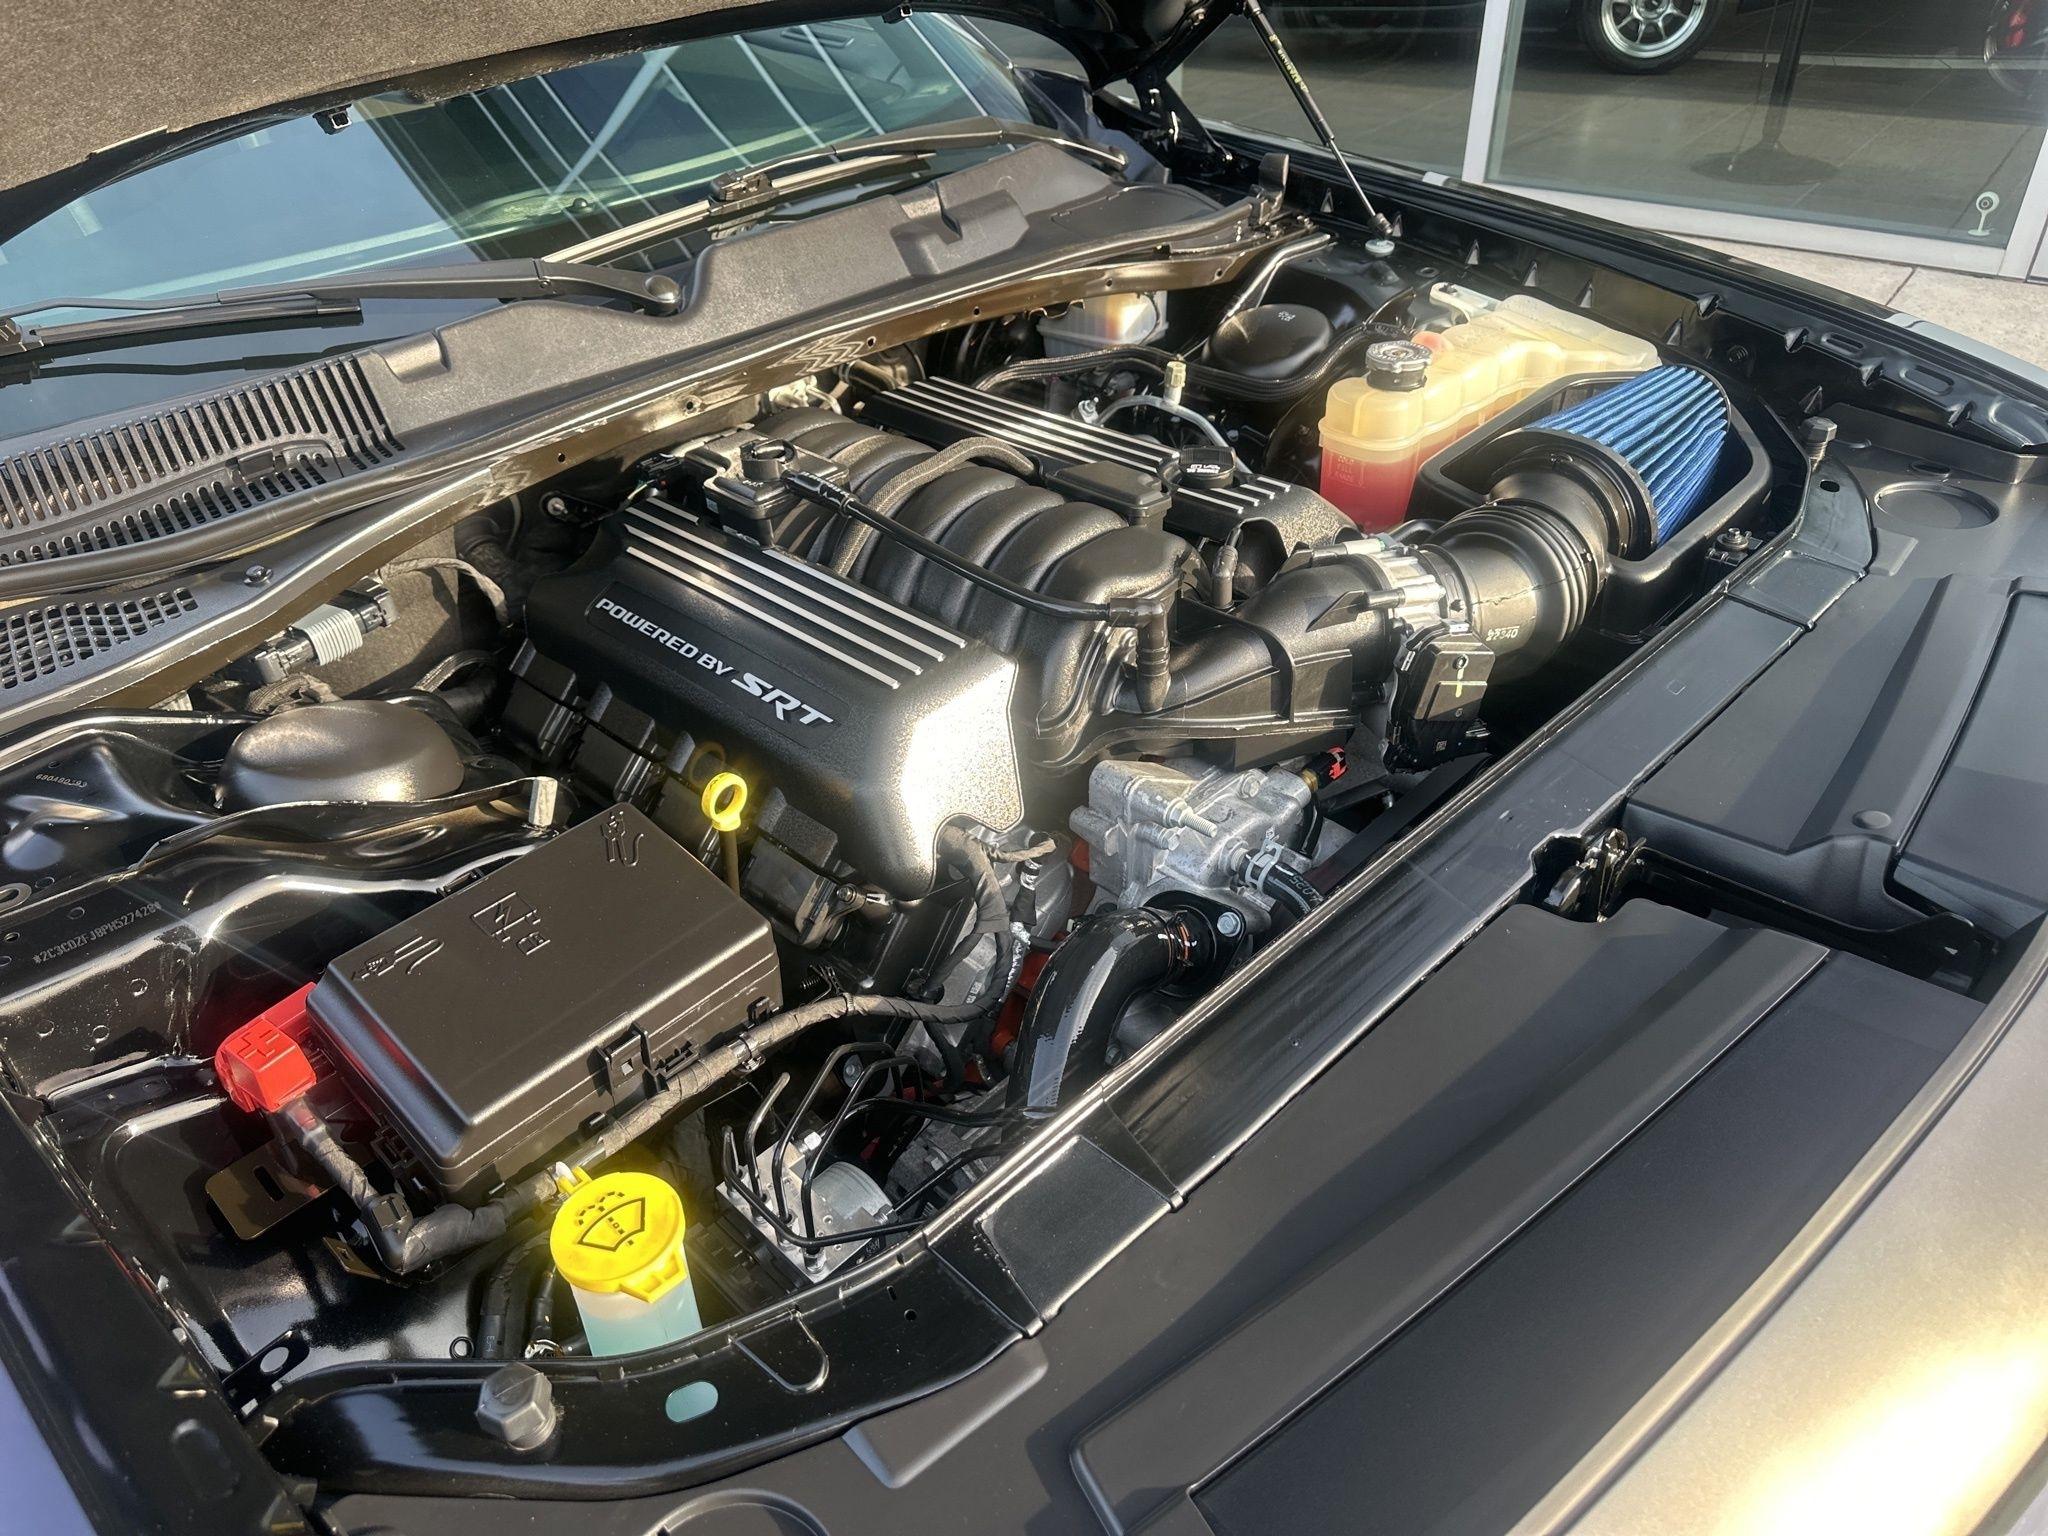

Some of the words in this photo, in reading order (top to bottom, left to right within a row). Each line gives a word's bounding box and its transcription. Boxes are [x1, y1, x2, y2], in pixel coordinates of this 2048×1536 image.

[595, 598, 700, 659] POWERED
[697, 653, 734, 676] BY
[731, 672, 834, 725] SRT
